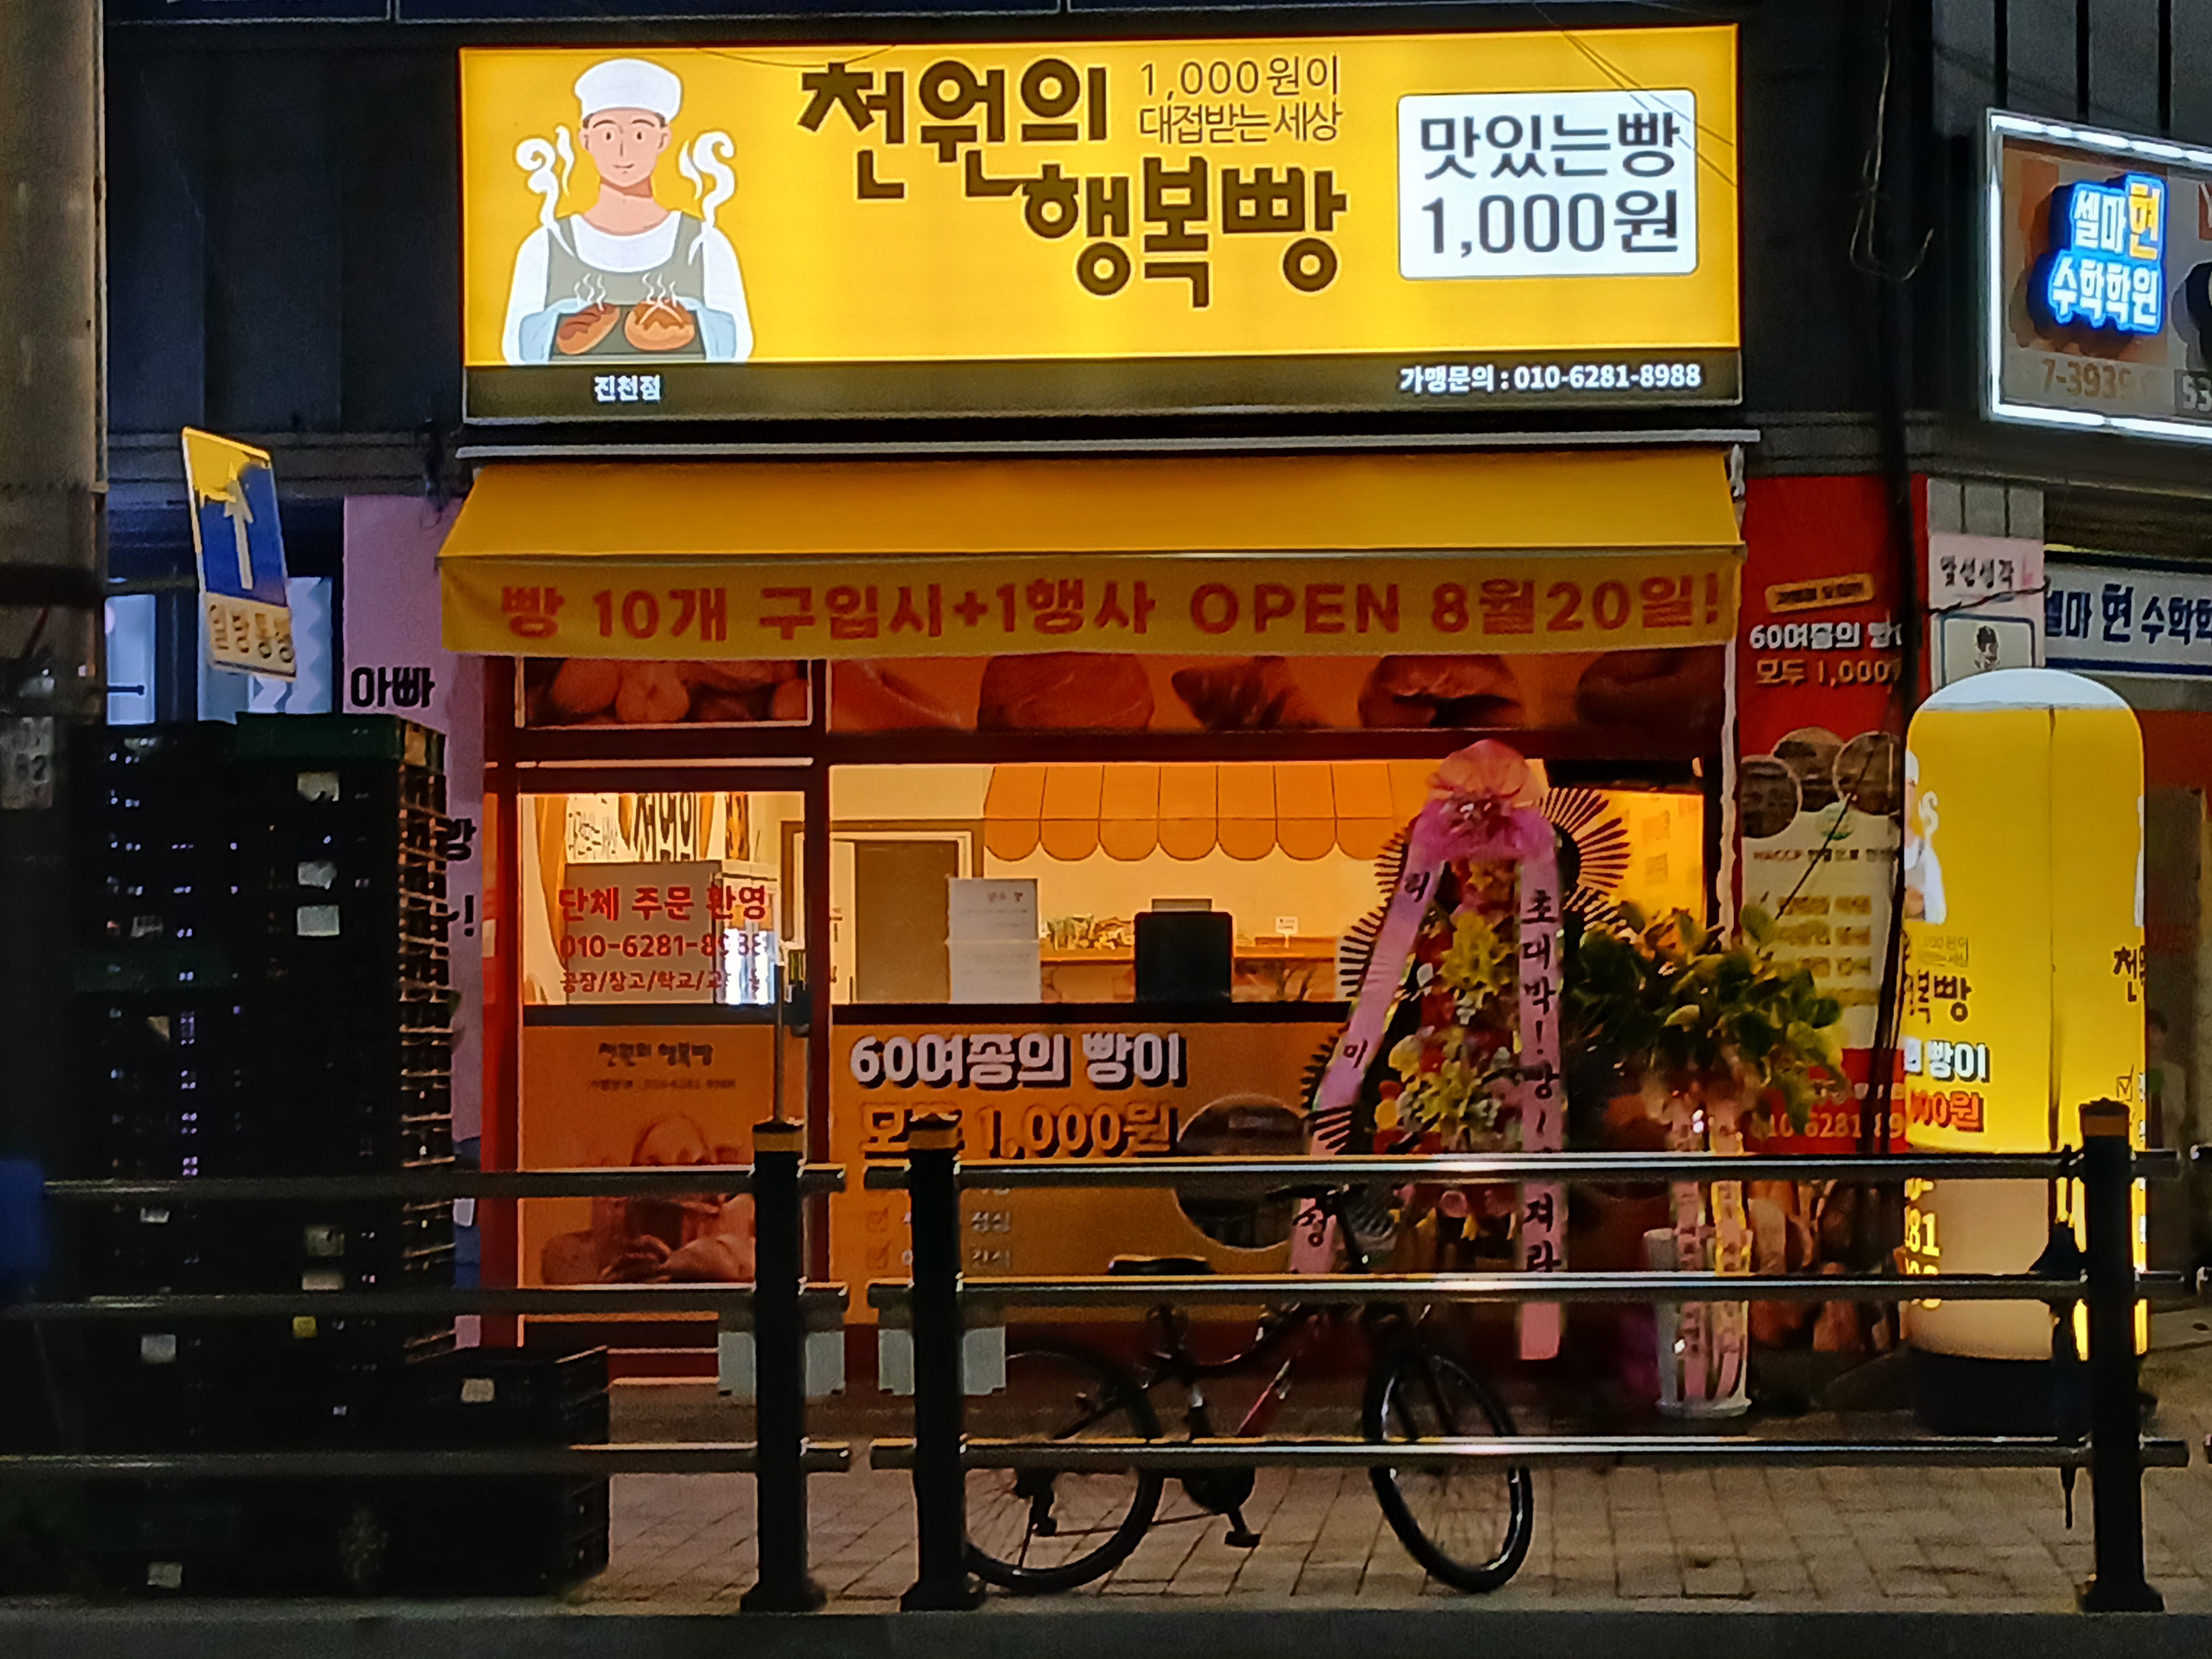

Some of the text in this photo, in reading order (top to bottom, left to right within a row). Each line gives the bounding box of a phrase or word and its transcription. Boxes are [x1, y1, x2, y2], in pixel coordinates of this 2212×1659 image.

[1140, 53, 1338, 102] 1,000원이
[797, 61, 1108, 201] 천원의
[1419, 111, 1681, 179] 맛있는빵
[1022, 155, 1348, 309] 행복빵
[1420, 190, 1680, 259] 1,000원
[2053, 257, 2159, 326] 수학학원
[595, 375, 660, 402] 진천점
[502, 586, 565, 639] 빵
[593, 587, 728, 641] 10개
[1191, 582, 1400, 635] OPEN
[350, 666, 435, 708] 아빠
[1757, 658, 1902, 687] 모두 1,000
[558, 885, 767, 922] 단체 주문 환영
[850, 1031, 1186, 1087] 60여종의 빵이
[976, 1099, 1176, 1159] 1,000원
